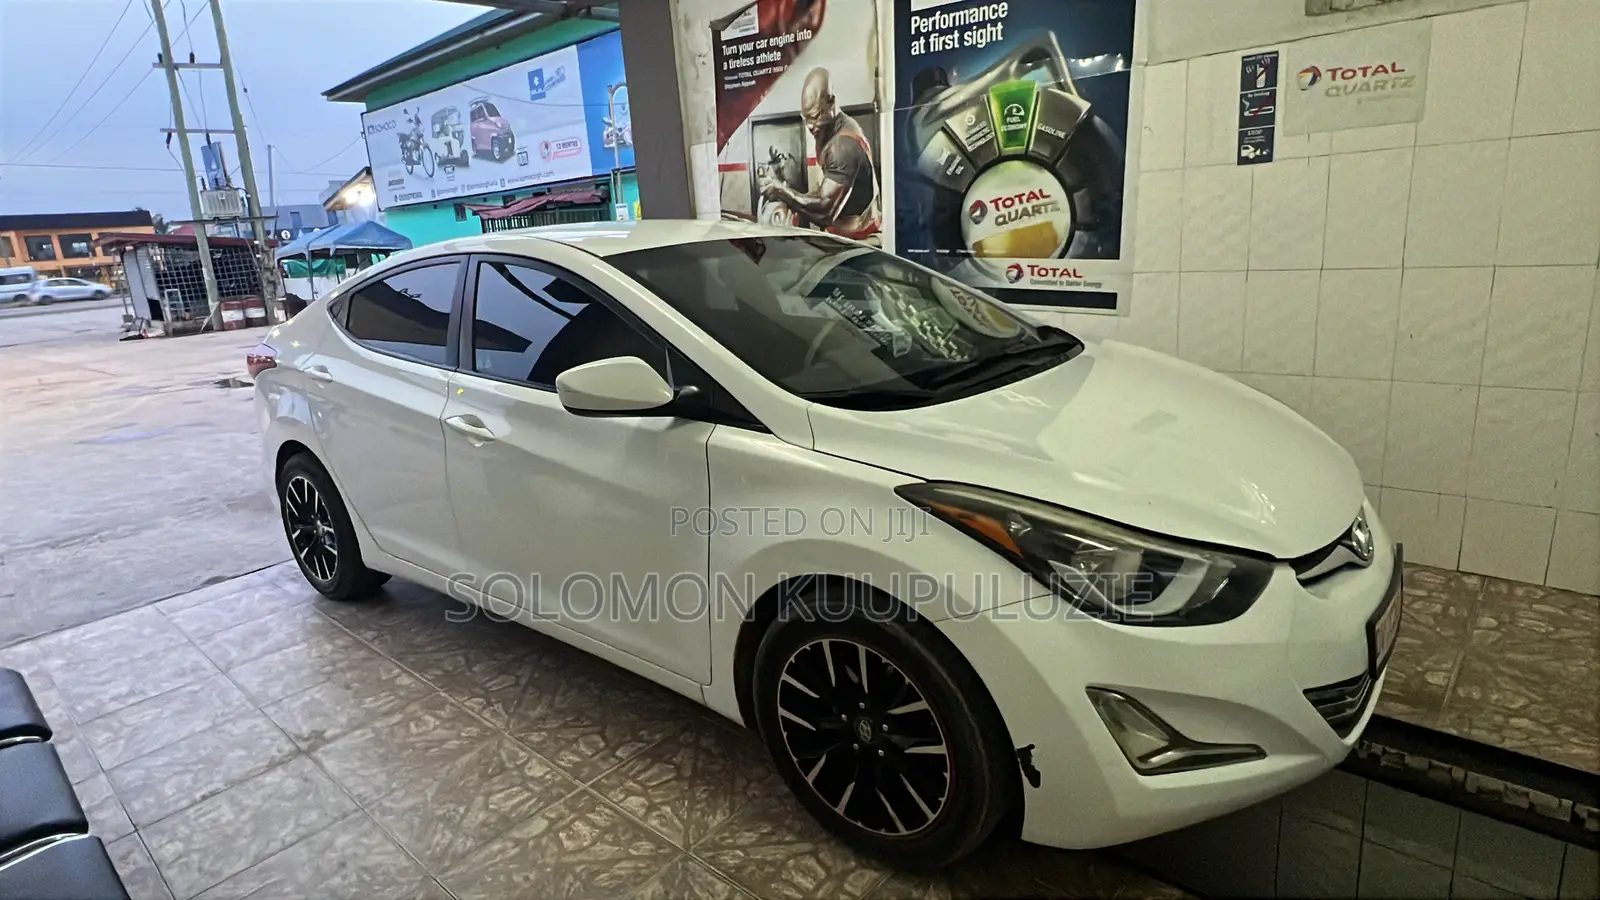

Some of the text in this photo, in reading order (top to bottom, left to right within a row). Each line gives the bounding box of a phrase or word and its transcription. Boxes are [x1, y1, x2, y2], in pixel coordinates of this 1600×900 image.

[911, 2, 1009, 35] Performance
[721, 29, 812, 56] Turn your car engine into
[910, 22, 1004, 56] at first sight
[723, 51, 782, 70] a tireless athlete
[1325, 62, 1406, 82] TOTAL
[1325, 75, 1417, 98] QUARTZ
[1037, 123, 1067, 139] GASOLINE
[989, 188, 1051, 213] TOTAL
[994, 200, 1061, 227] QUARTZ
[1027, 264, 1083, 279] TOTAL
